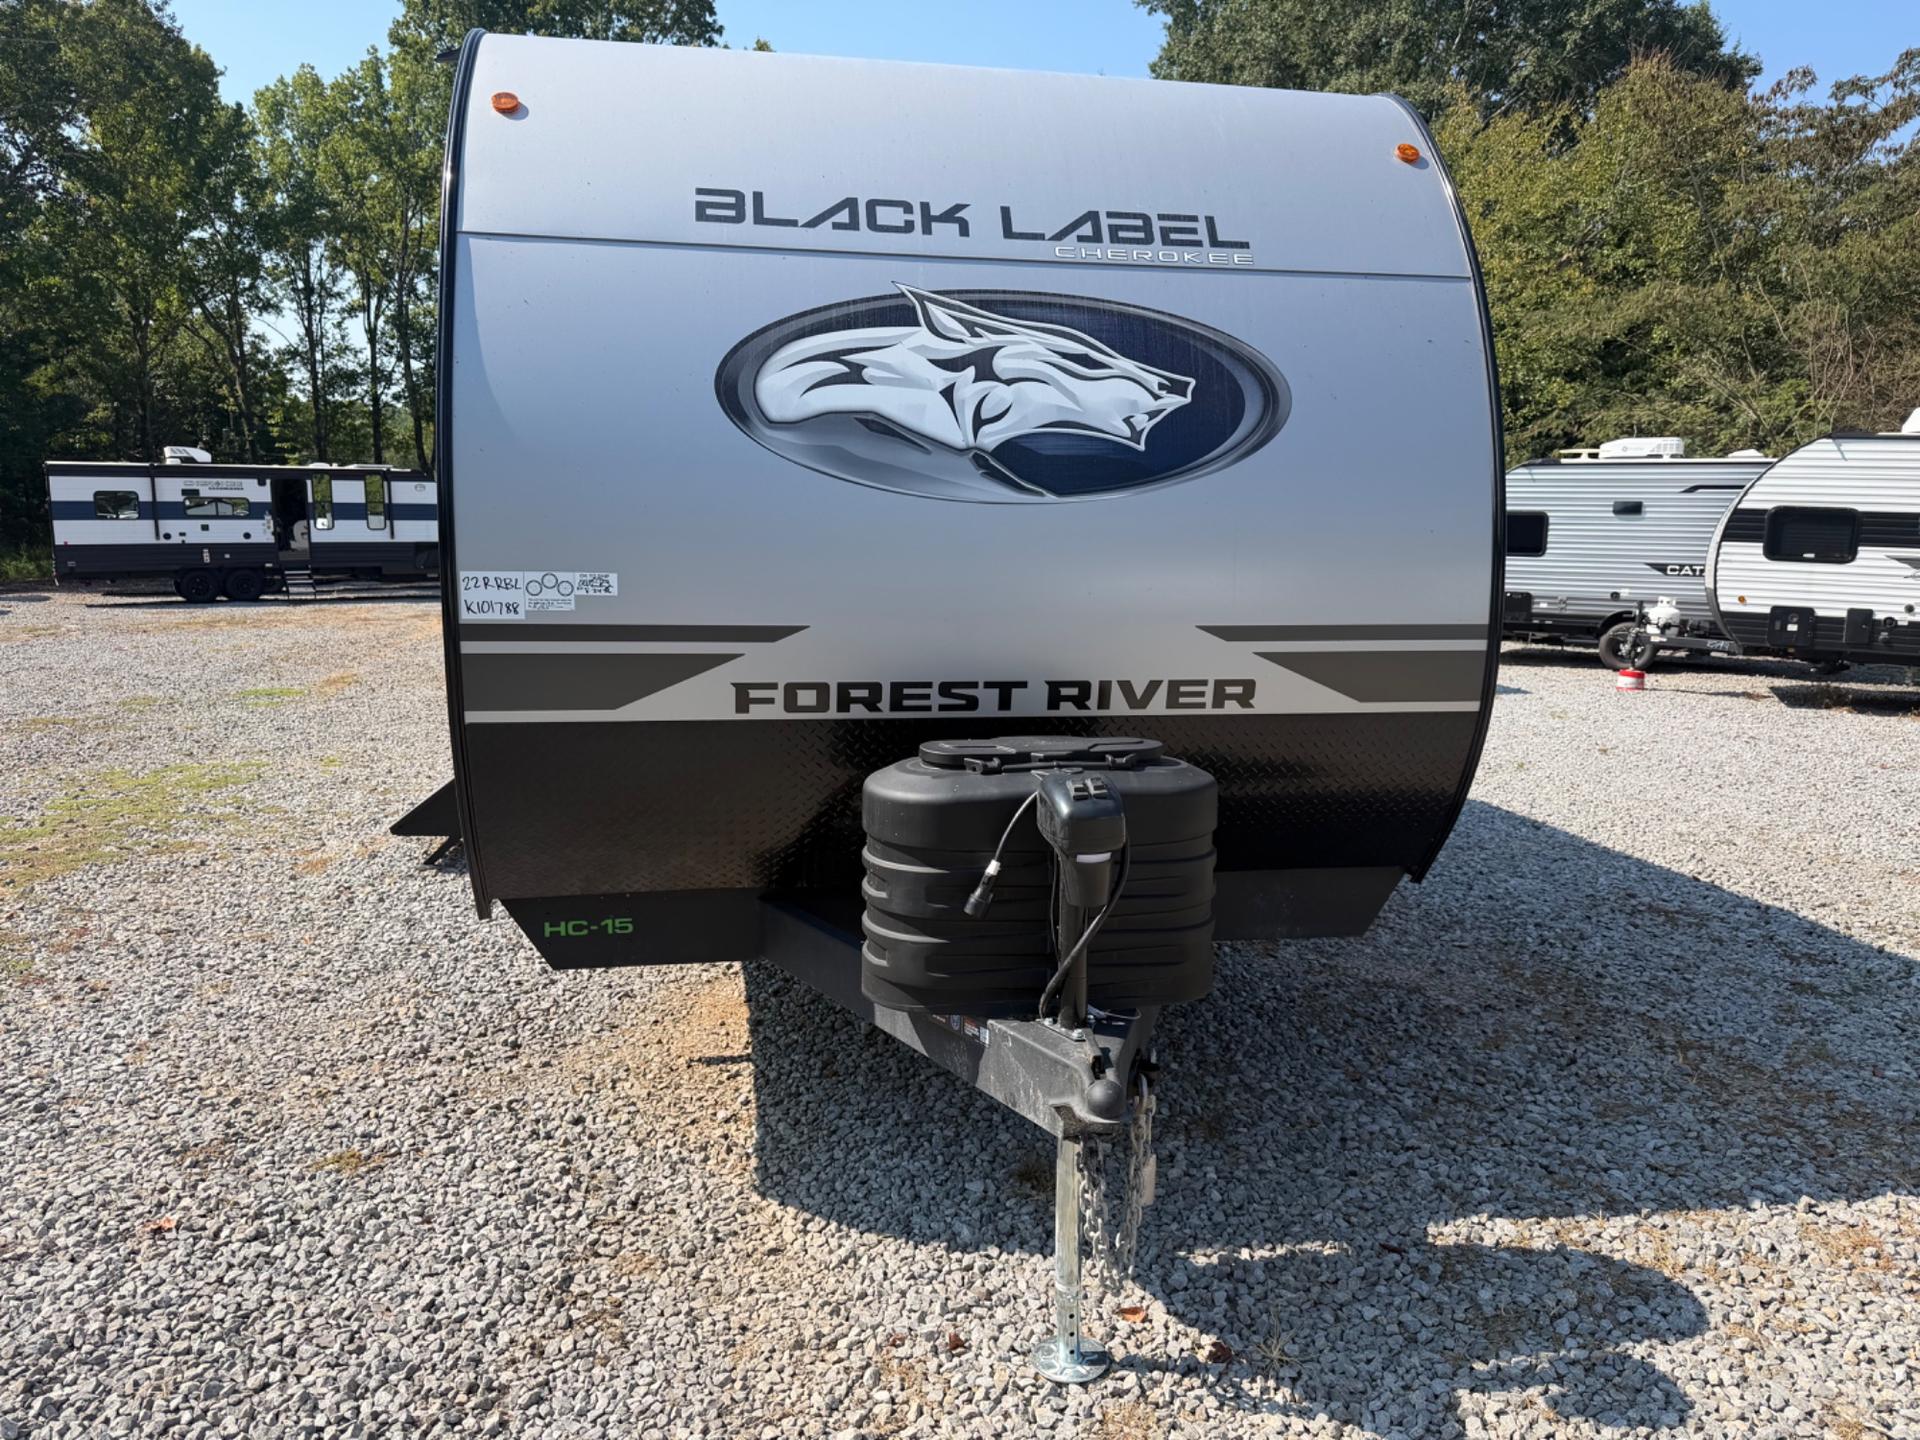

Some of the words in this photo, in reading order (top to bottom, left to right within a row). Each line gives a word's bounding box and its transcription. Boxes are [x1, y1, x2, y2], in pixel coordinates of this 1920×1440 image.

[694, 187, 971, 237] BLACK
[1000, 205, 1250, 249] LABEL
[1055, 246, 1254, 265] CHEROKEE
[1666, 564, 1705, 576] CAT
[730, 680, 1028, 714] FOREST
[1045, 679, 1257, 711] RIVER
[543, 918, 633, 938] HC-15
